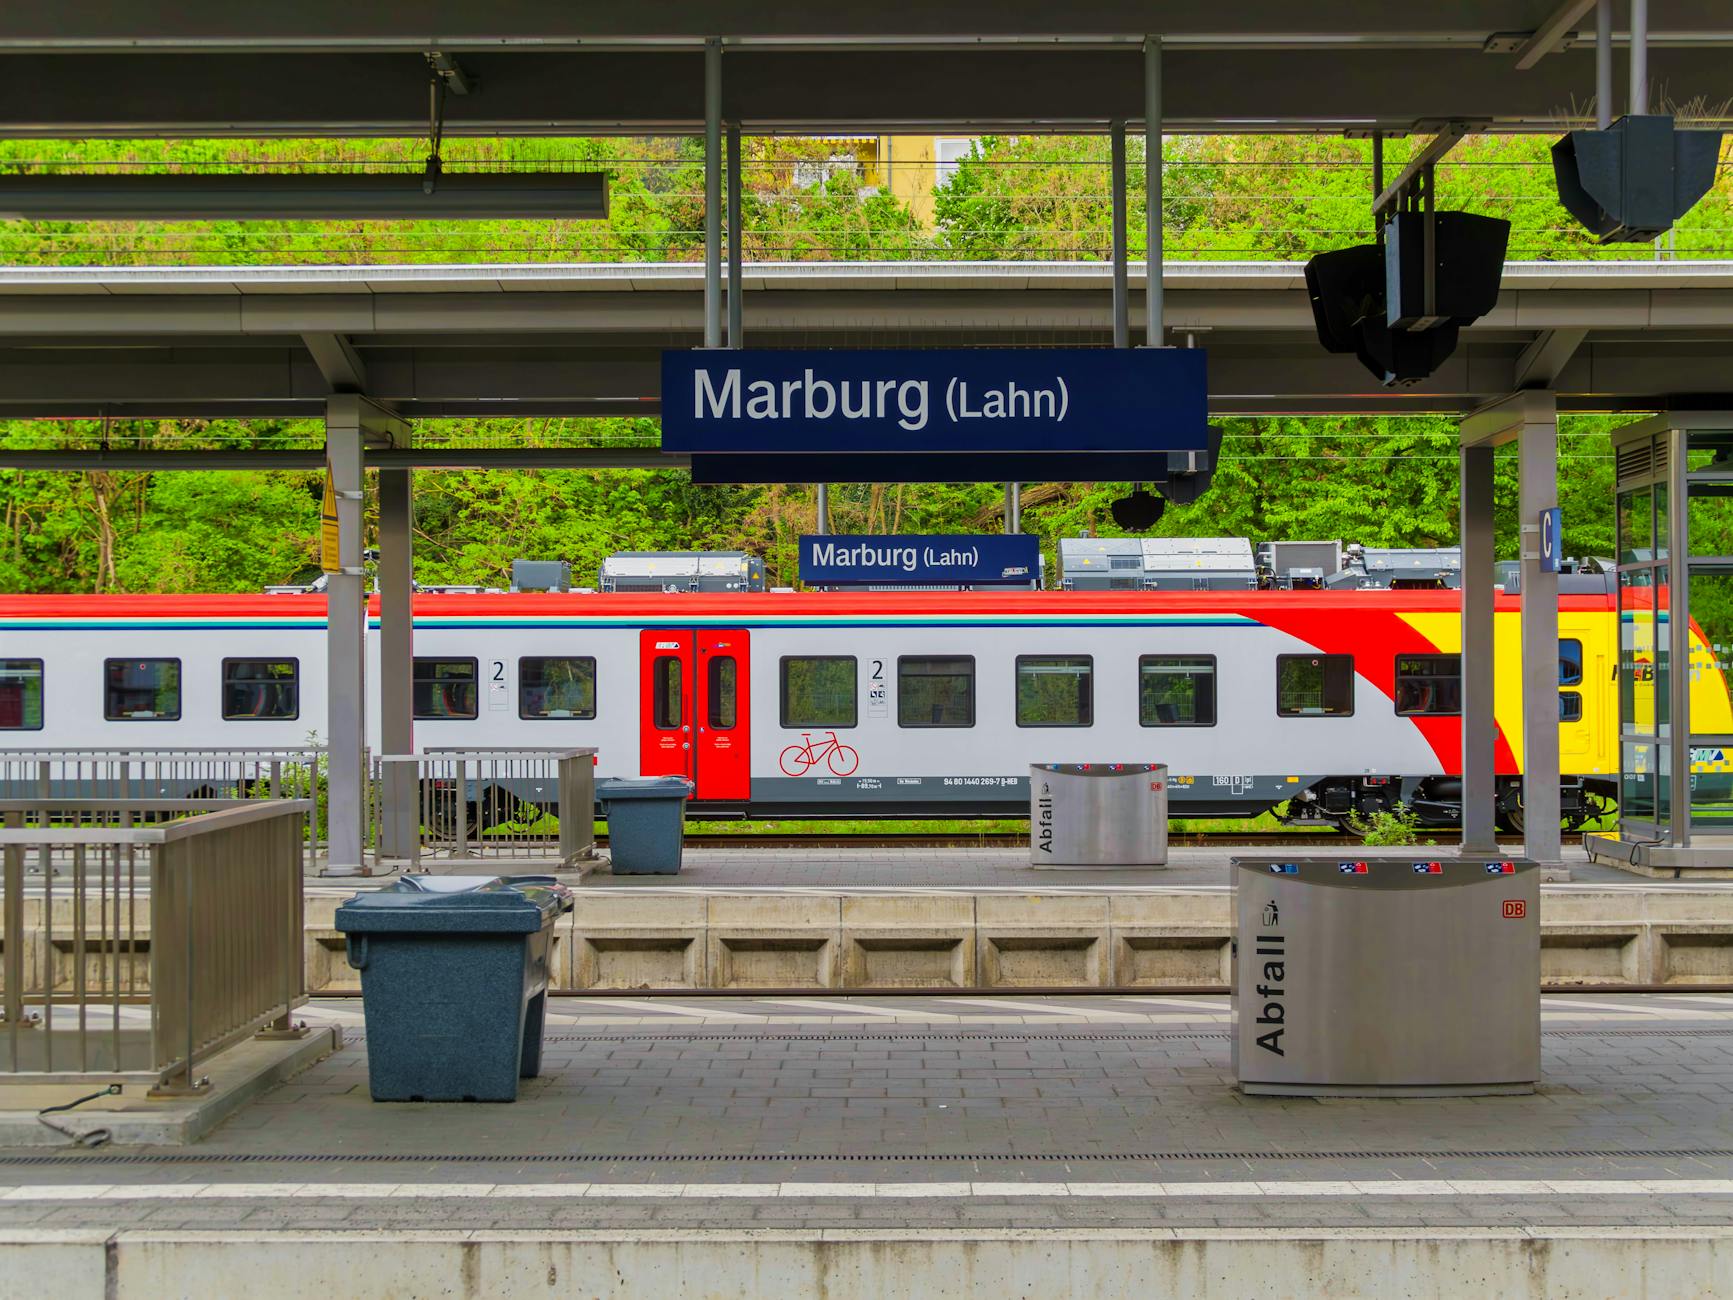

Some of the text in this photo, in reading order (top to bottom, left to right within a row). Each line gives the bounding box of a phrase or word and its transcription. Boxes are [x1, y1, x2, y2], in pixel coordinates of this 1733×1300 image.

[694, 368, 1069, 431] Marburg (Lahn)
[1543, 511, 1552, 559] C
[812, 543, 979, 571] Marburg (Lahn)
[493, 661, 504, 681] 2
[872, 660, 883, 680] 2
[1216, 776, 1229, 784] 160
[1039, 798, 1052, 853] Abfall
[1504, 902, 1524, 916] DB
[1256, 935, 1285, 1057] Abfall
